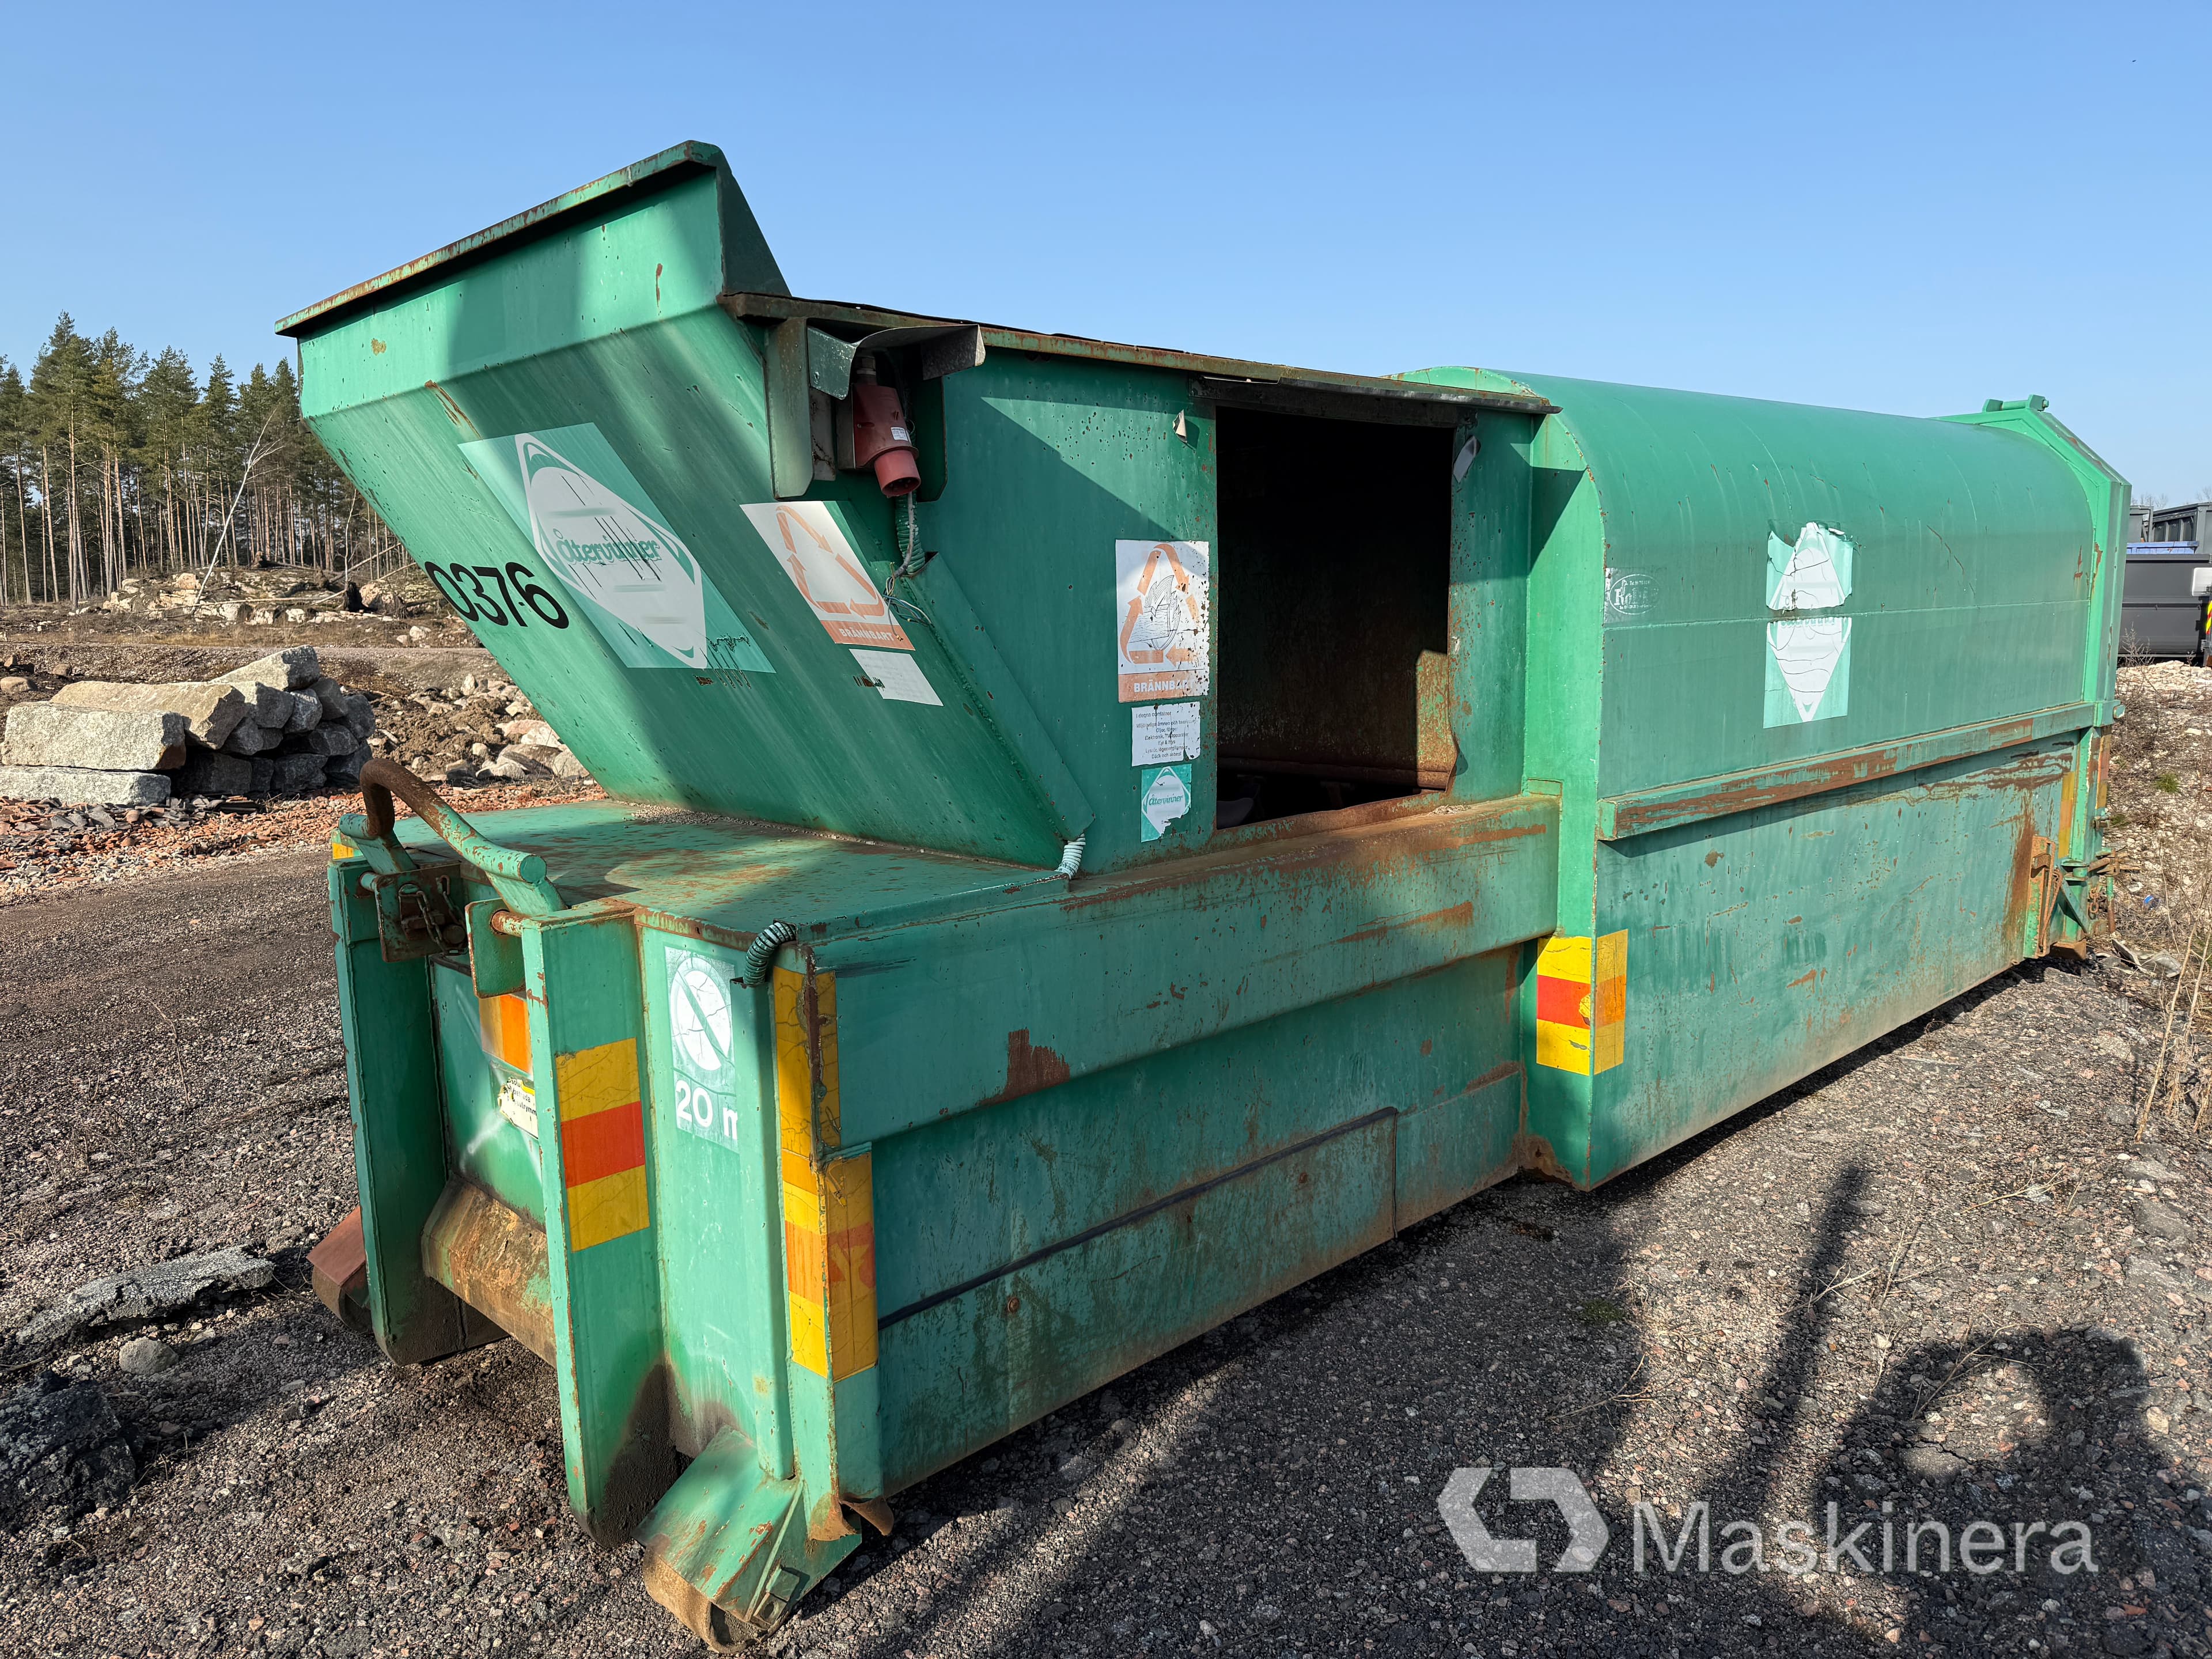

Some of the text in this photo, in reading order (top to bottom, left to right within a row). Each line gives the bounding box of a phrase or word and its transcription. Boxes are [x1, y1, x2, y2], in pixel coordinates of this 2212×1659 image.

[425, 561, 569, 629] 0376
[839, 627, 895, 641] BRÄNNBART
[1133, 679, 1195, 692] BRÄNNBART
[1148, 794, 1184, 806] återvinner
[676, 1080, 713, 1127] 20
